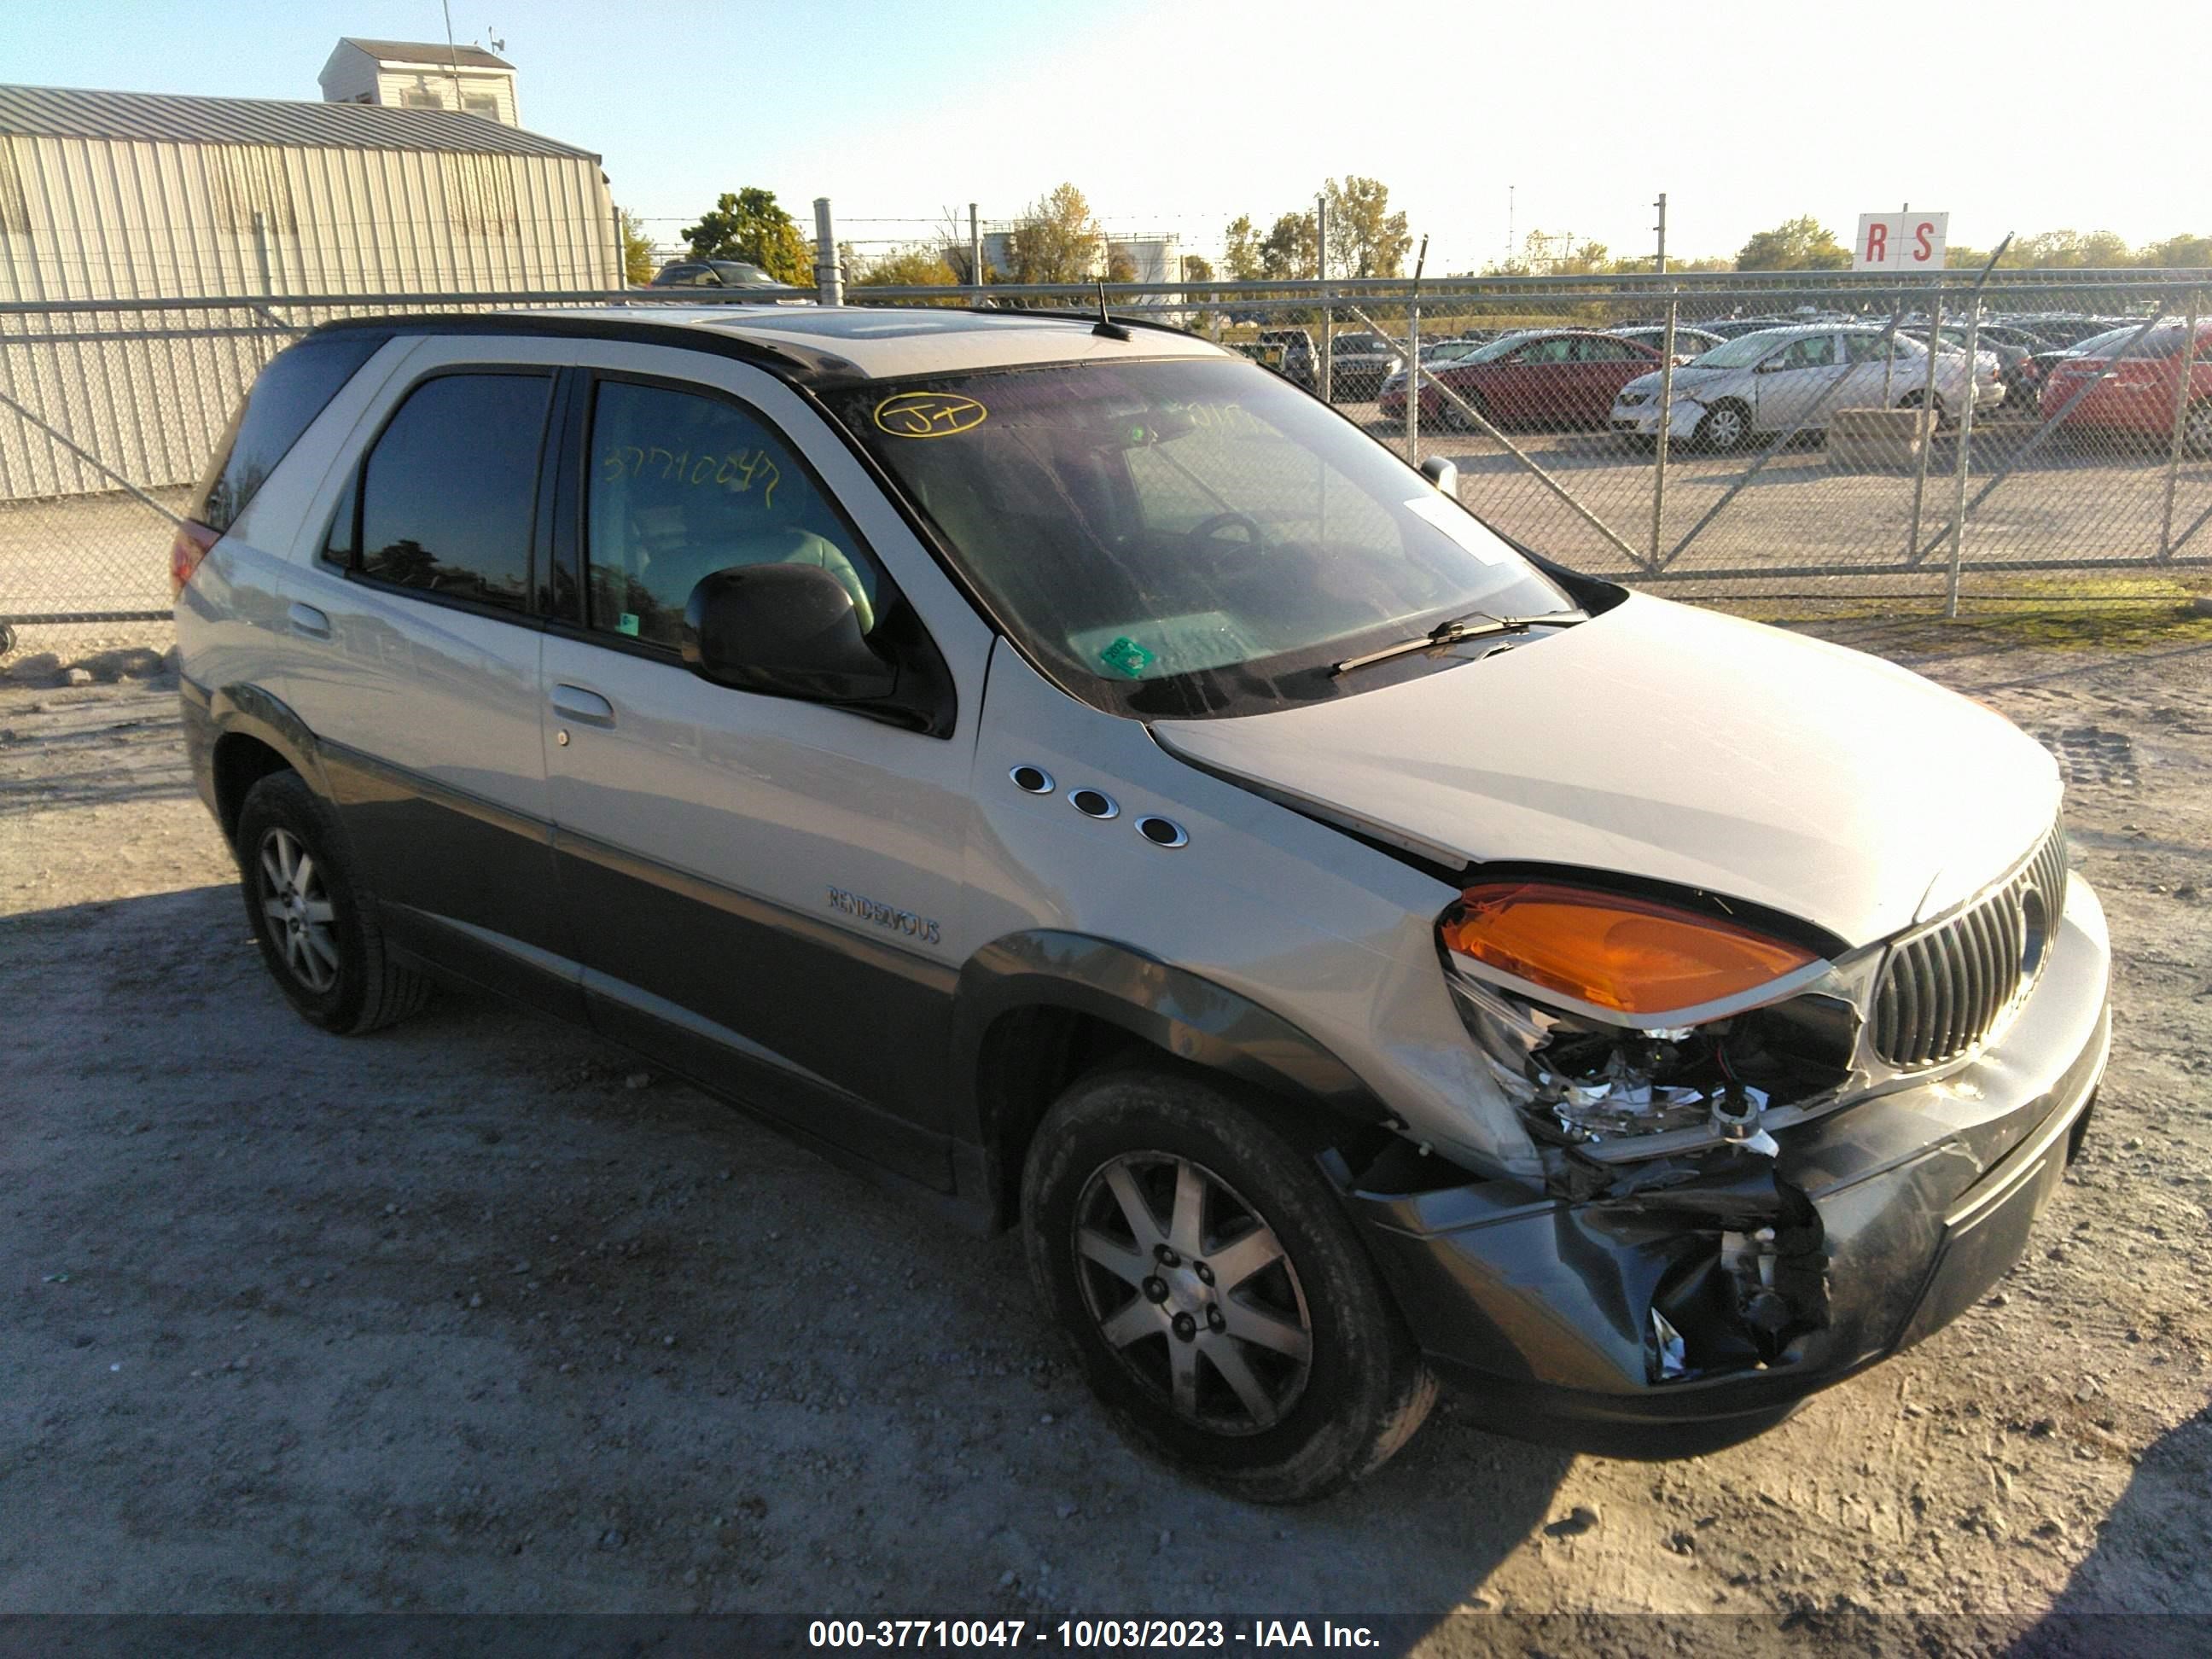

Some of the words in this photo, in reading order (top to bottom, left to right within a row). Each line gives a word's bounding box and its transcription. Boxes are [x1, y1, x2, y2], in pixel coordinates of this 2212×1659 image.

[1866, 223, 1888, 262] R
[1913, 222, 1935, 261] S
[604, 445, 780, 509] 37710047
